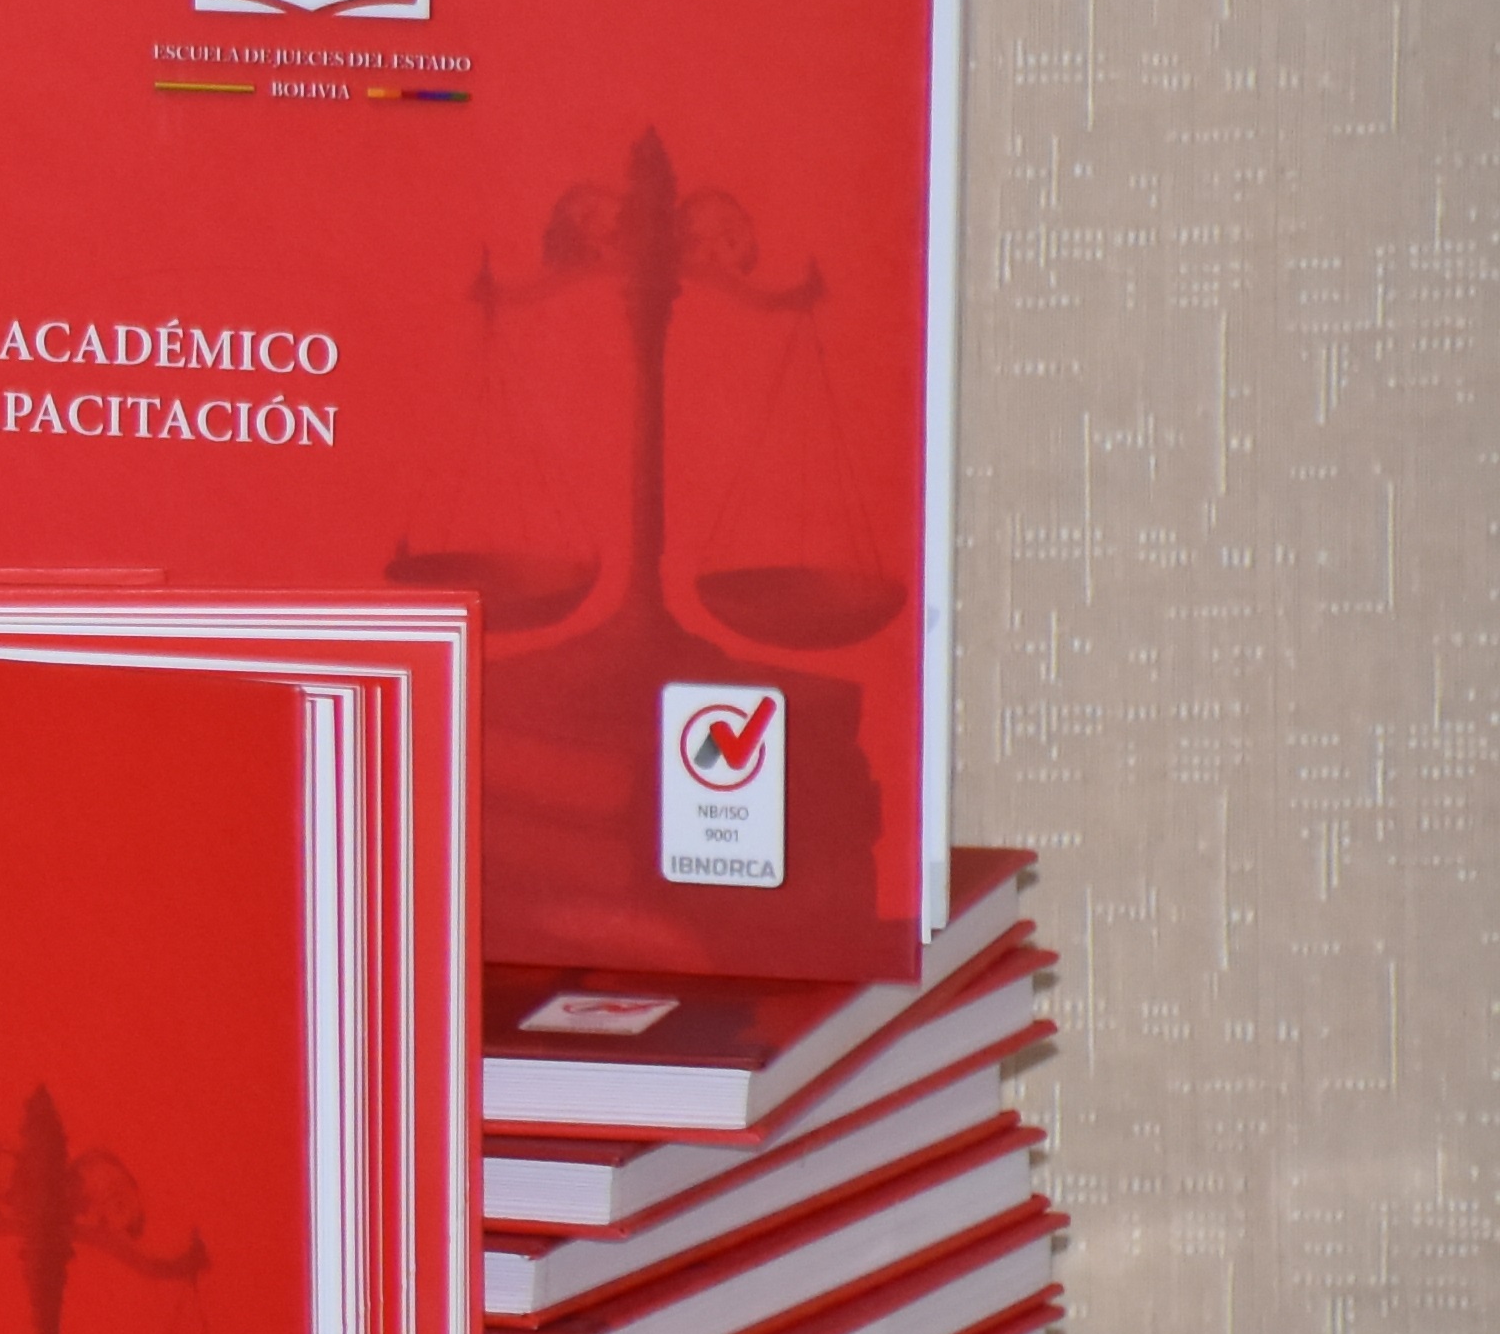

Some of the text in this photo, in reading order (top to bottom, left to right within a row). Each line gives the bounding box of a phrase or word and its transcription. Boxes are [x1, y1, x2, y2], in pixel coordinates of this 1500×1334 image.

[153, 44, 471, 72] ESCUELA DE JUECES DEL ESTADO
[271, 82, 350, 99] BOLIVIA
[698, 805, 749, 820] NB/ISO
[705, 829, 739, 842] 9001
[671, 856, 776, 878] IBNORCA
